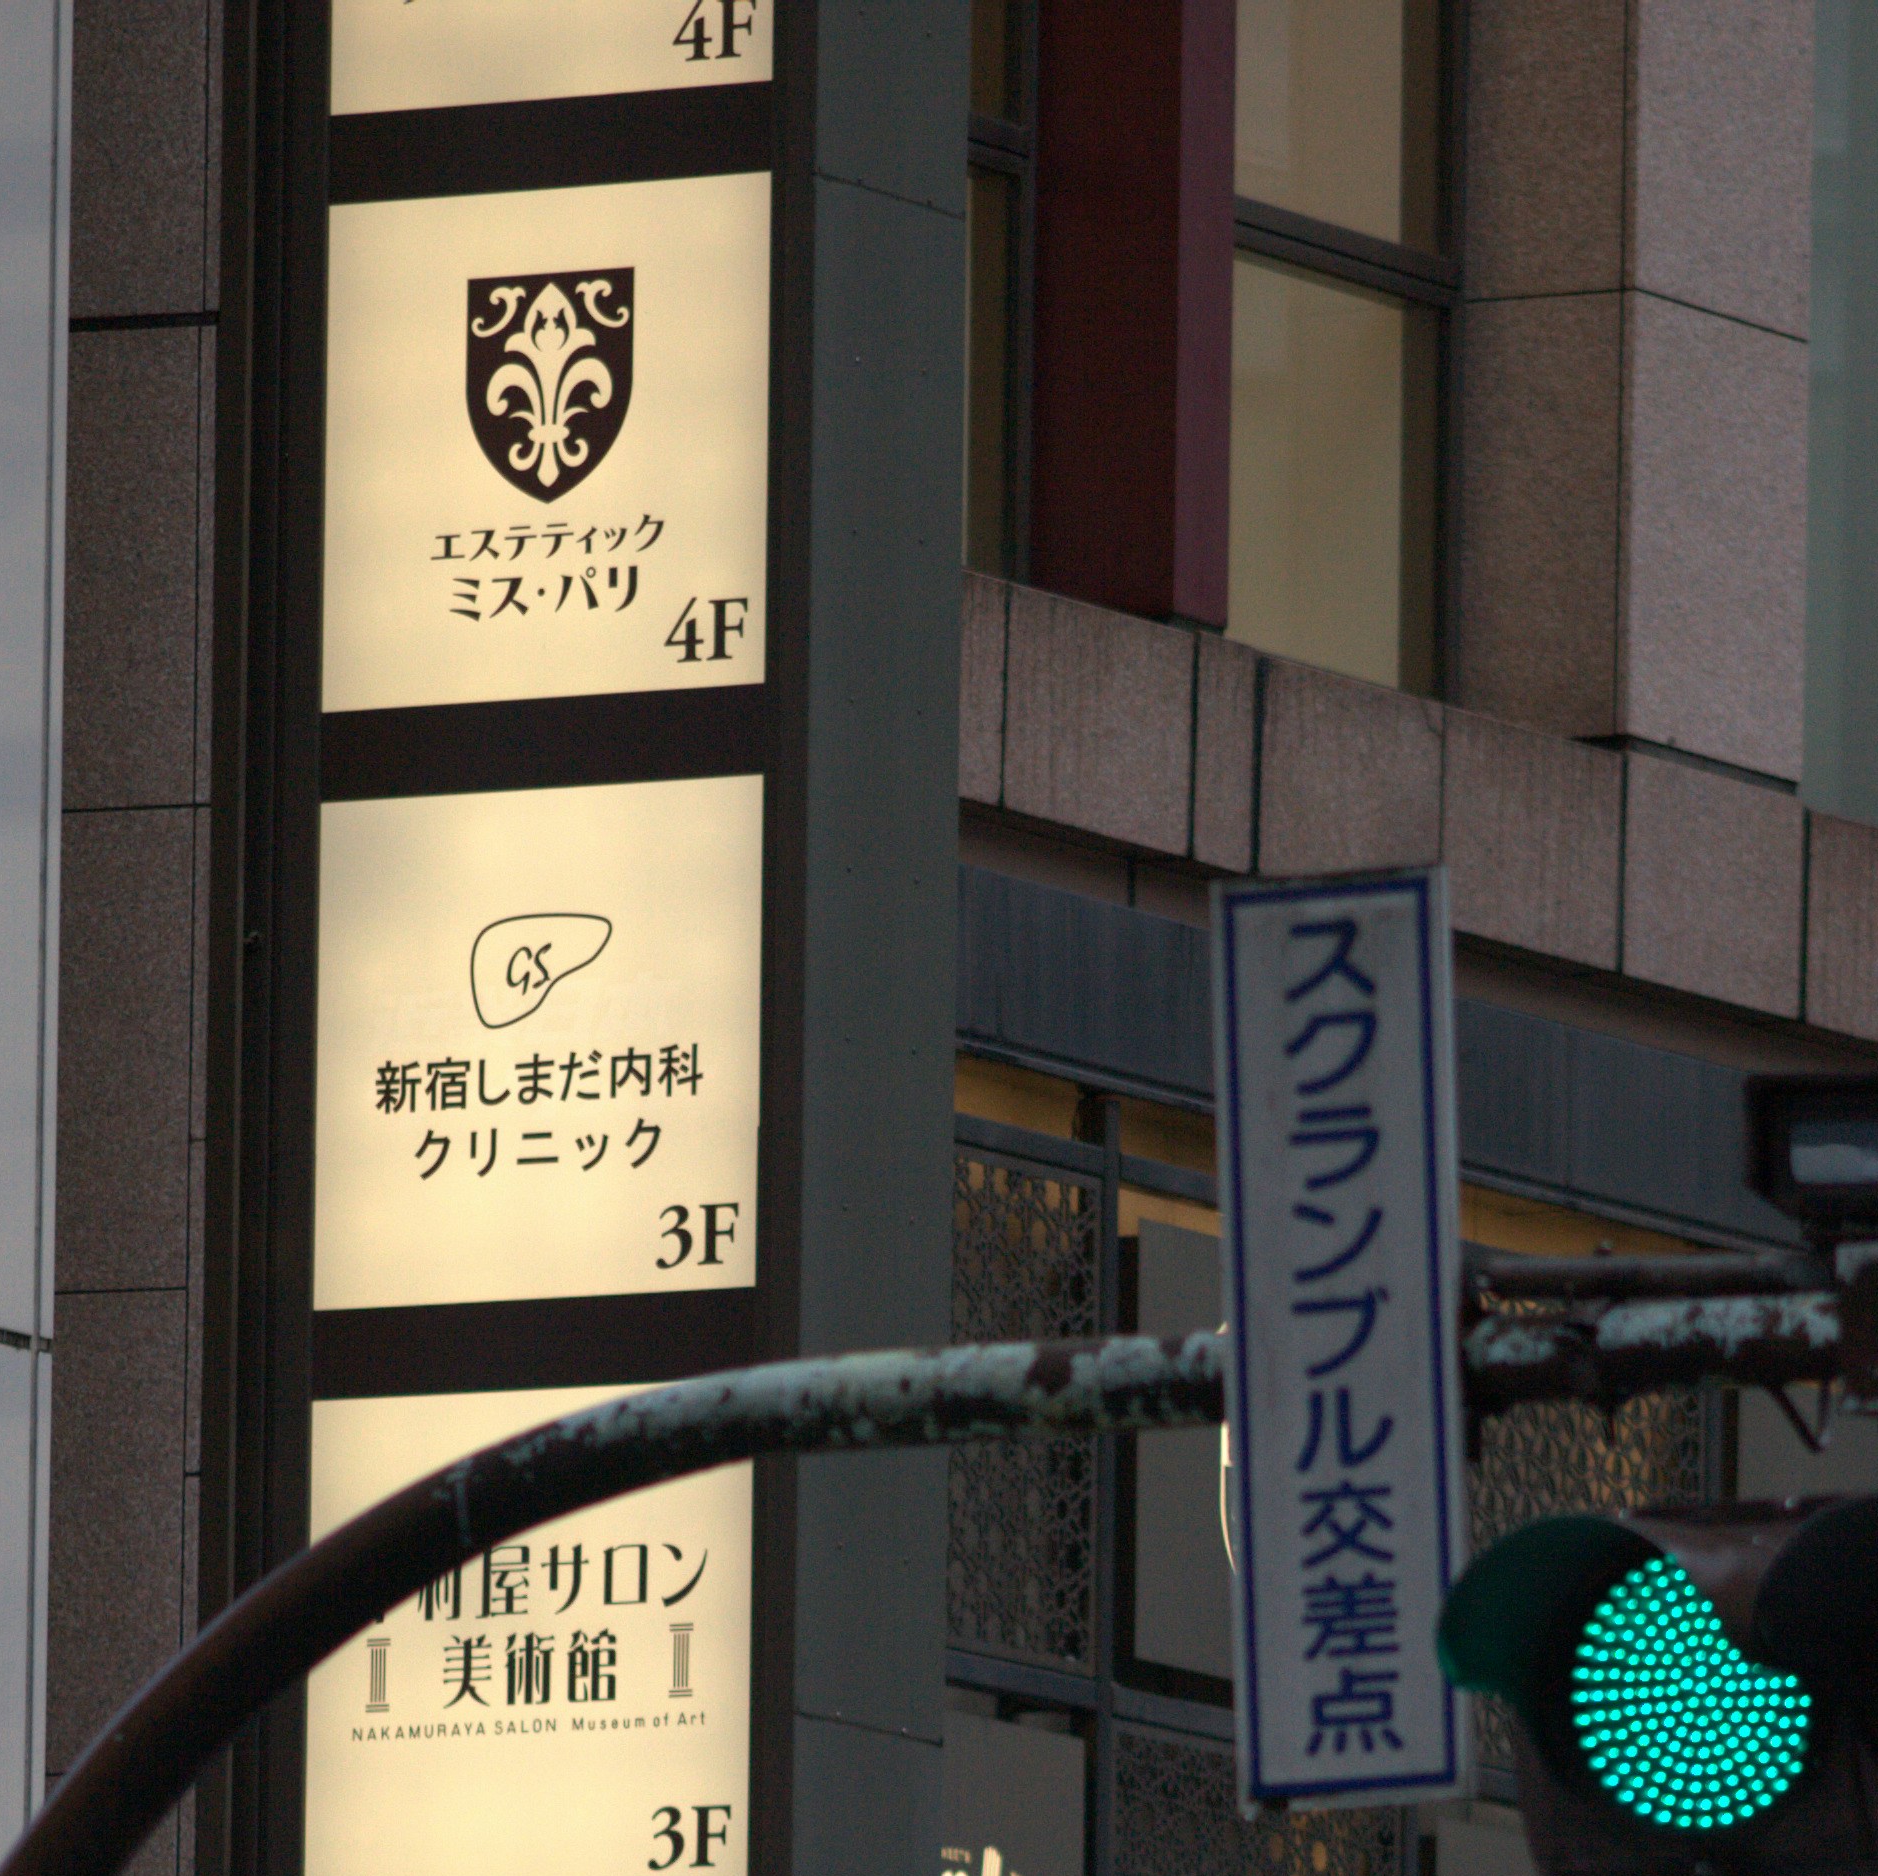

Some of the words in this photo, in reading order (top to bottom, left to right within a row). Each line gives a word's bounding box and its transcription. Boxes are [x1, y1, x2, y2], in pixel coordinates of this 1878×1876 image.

[672, 0, 756, 61] 4F
[430, 514, 666, 561] エステティック
[449, 565, 639, 621] ミス・パリ
[663, 596, 748, 663] 4F
[375, 1043, 703, 1114] 新宿しまだ内科
[414, 1118, 662, 1180] クリニック
[656, 1202, 739, 1269] 3F
[1284, 914, 1402, 1758] スクランブル交差点
[443, 1628, 617, 1710] 美術館
[352, 1722, 486, 1742] NAKAMURAYA
[494, 1718, 557, 1736] SALON
[572, 1714, 646, 1731] Museum
[653, 1712, 670, 1727] of
[677, 1710, 707, 1727] Art
[648, 1805, 732, 1870] 3F
